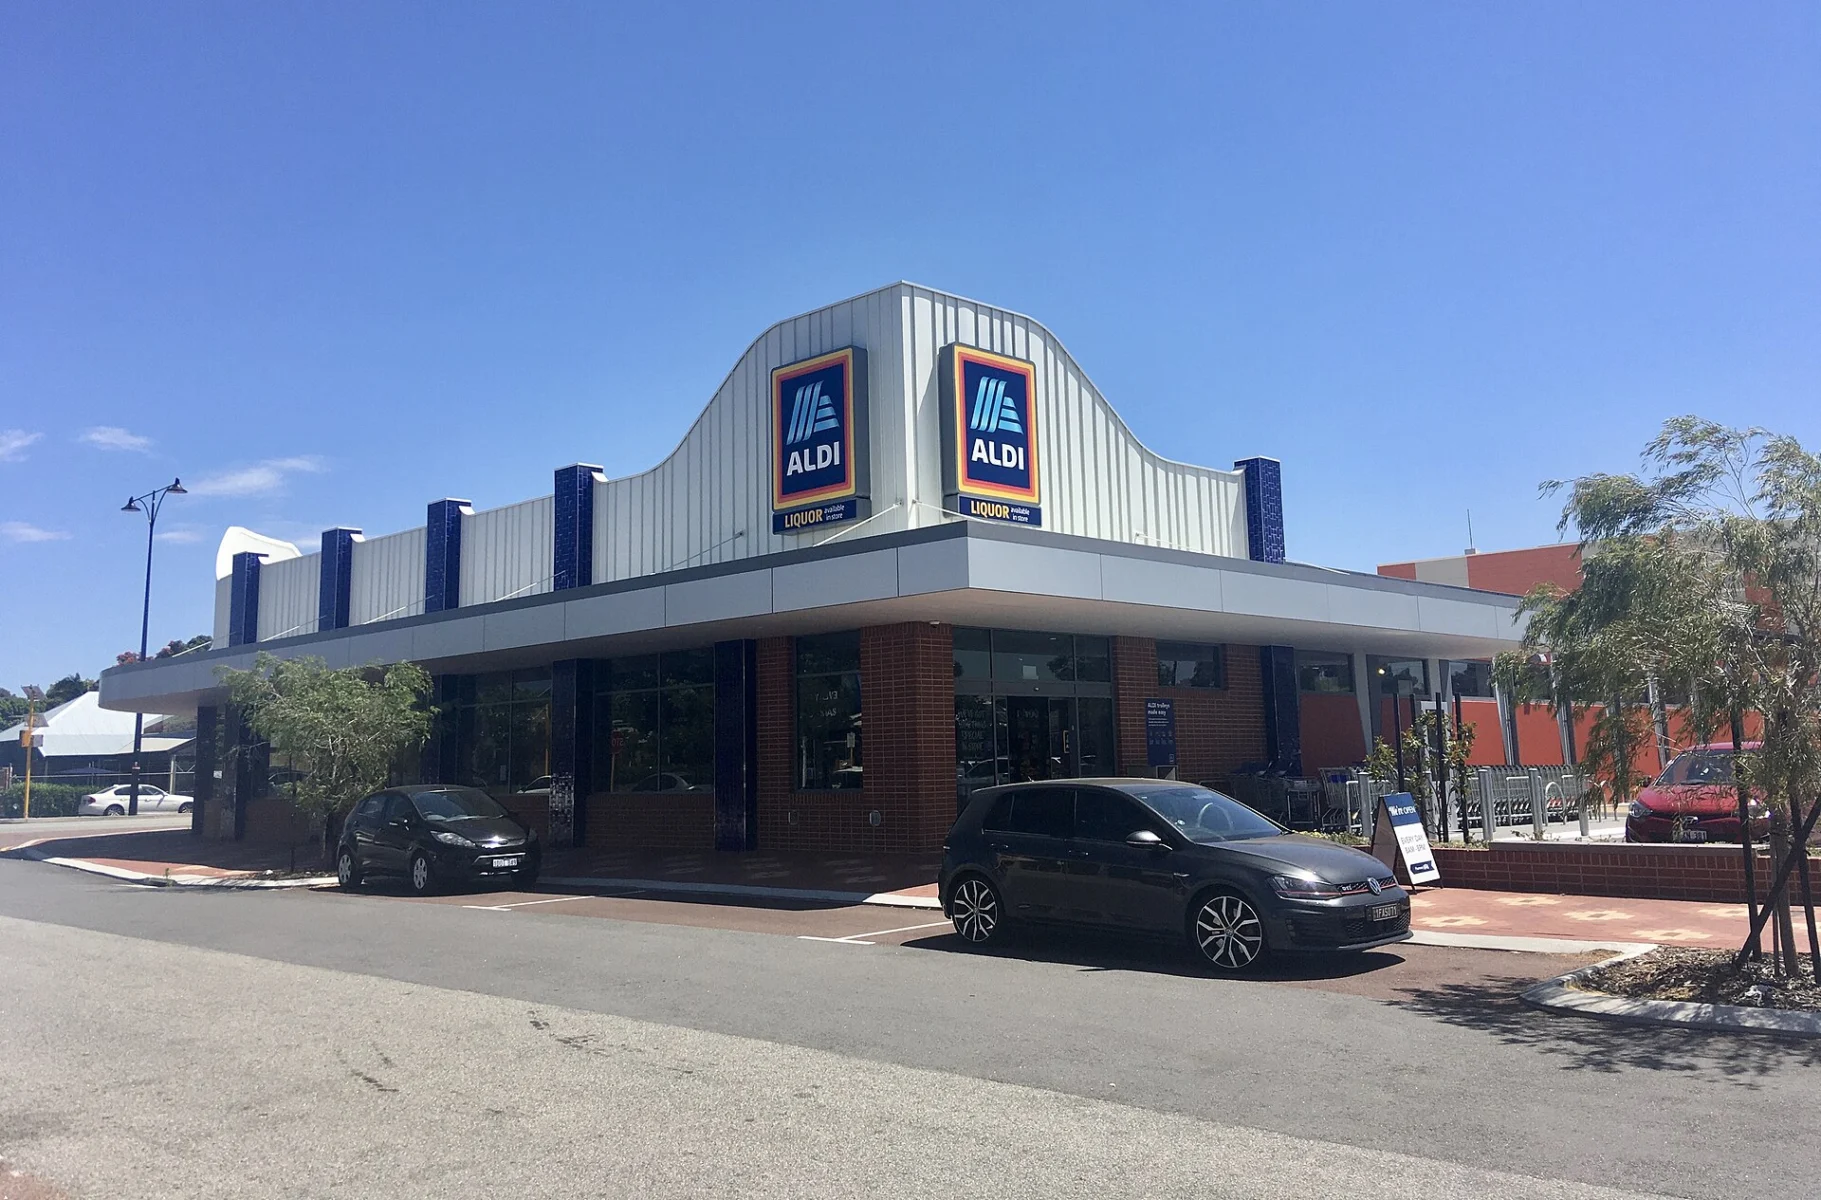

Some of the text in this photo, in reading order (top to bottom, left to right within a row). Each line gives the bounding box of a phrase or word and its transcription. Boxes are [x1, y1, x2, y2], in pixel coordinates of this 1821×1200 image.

[786, 441, 840, 476] ALDI
[971, 438, 1024, 471] ALDI
[784, 504, 845, 529] LIQUOR available
[831, 513, 843, 521] store
[971, 500, 1030, 519] LIQUOR available
[1017, 514, 1029, 522] store
